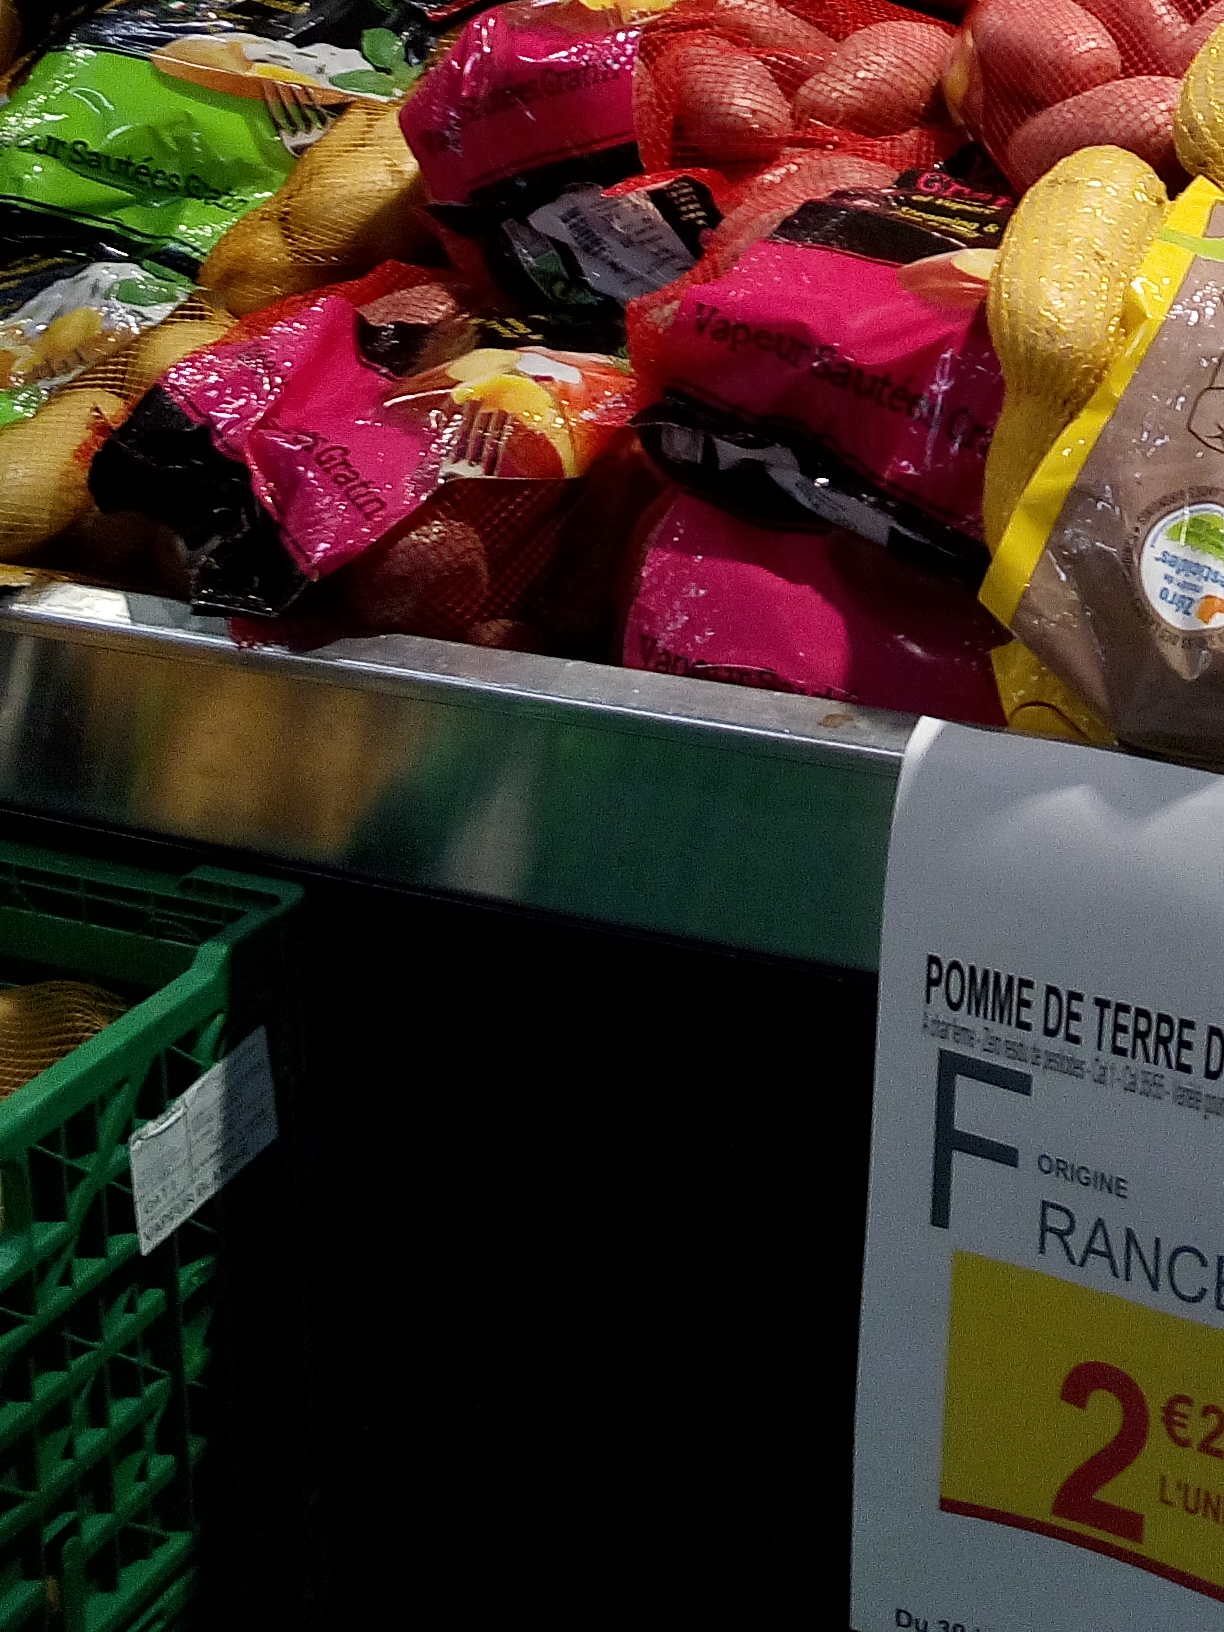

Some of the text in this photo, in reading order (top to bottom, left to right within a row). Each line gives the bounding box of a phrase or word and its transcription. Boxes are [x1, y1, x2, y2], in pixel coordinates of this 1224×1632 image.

[926, 952, 1035, 1032] POMME
[1043, 982, 1085, 1046] DE
[1093, 994, 1196, 1075] TERRE
[1037, 1152, 1129, 1200] ORIGINE
